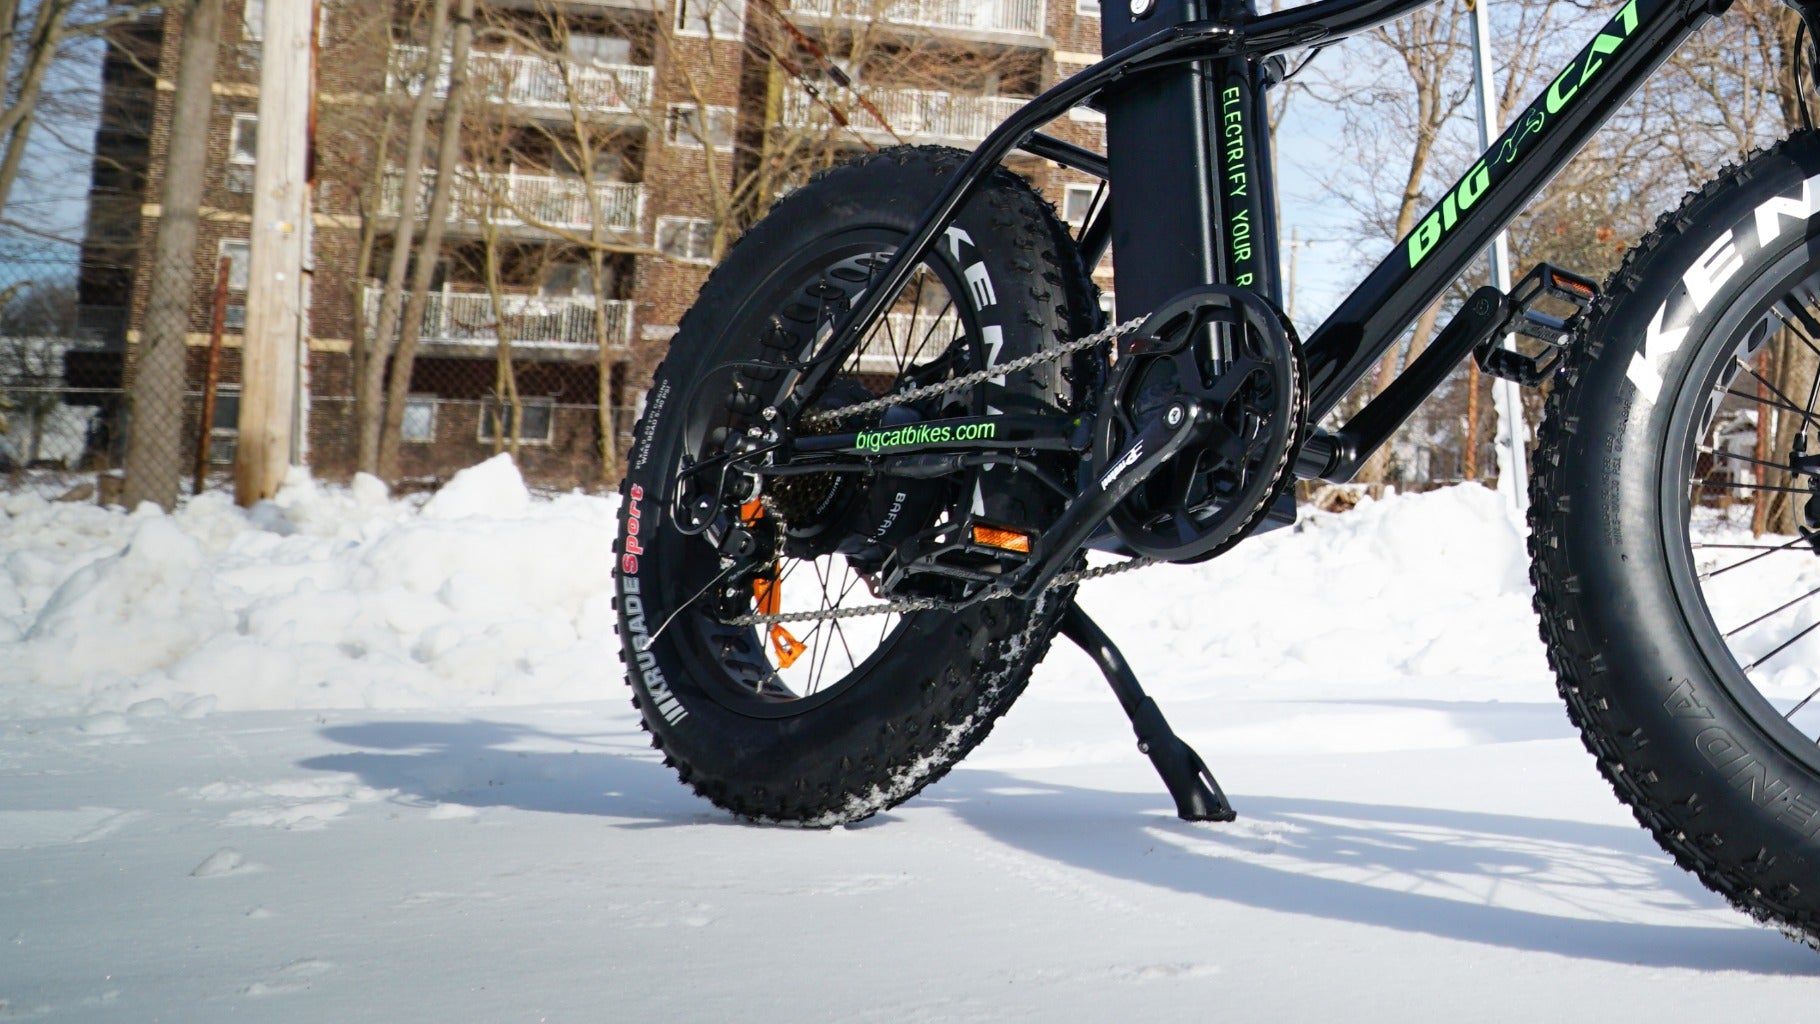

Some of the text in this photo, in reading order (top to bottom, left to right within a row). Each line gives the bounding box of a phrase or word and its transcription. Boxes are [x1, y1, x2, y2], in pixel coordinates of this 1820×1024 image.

[1222, 86, 1247, 198] ELECTRIFY
[1231, 209, 1252, 264] YOUR
[1407, 159, 1490, 269] BIG
[855, 422, 995, 451] bigcatbikes.com
[877, 492, 908, 538] BAFAN
[622, 483, 673, 706] KRUSADE Sport
